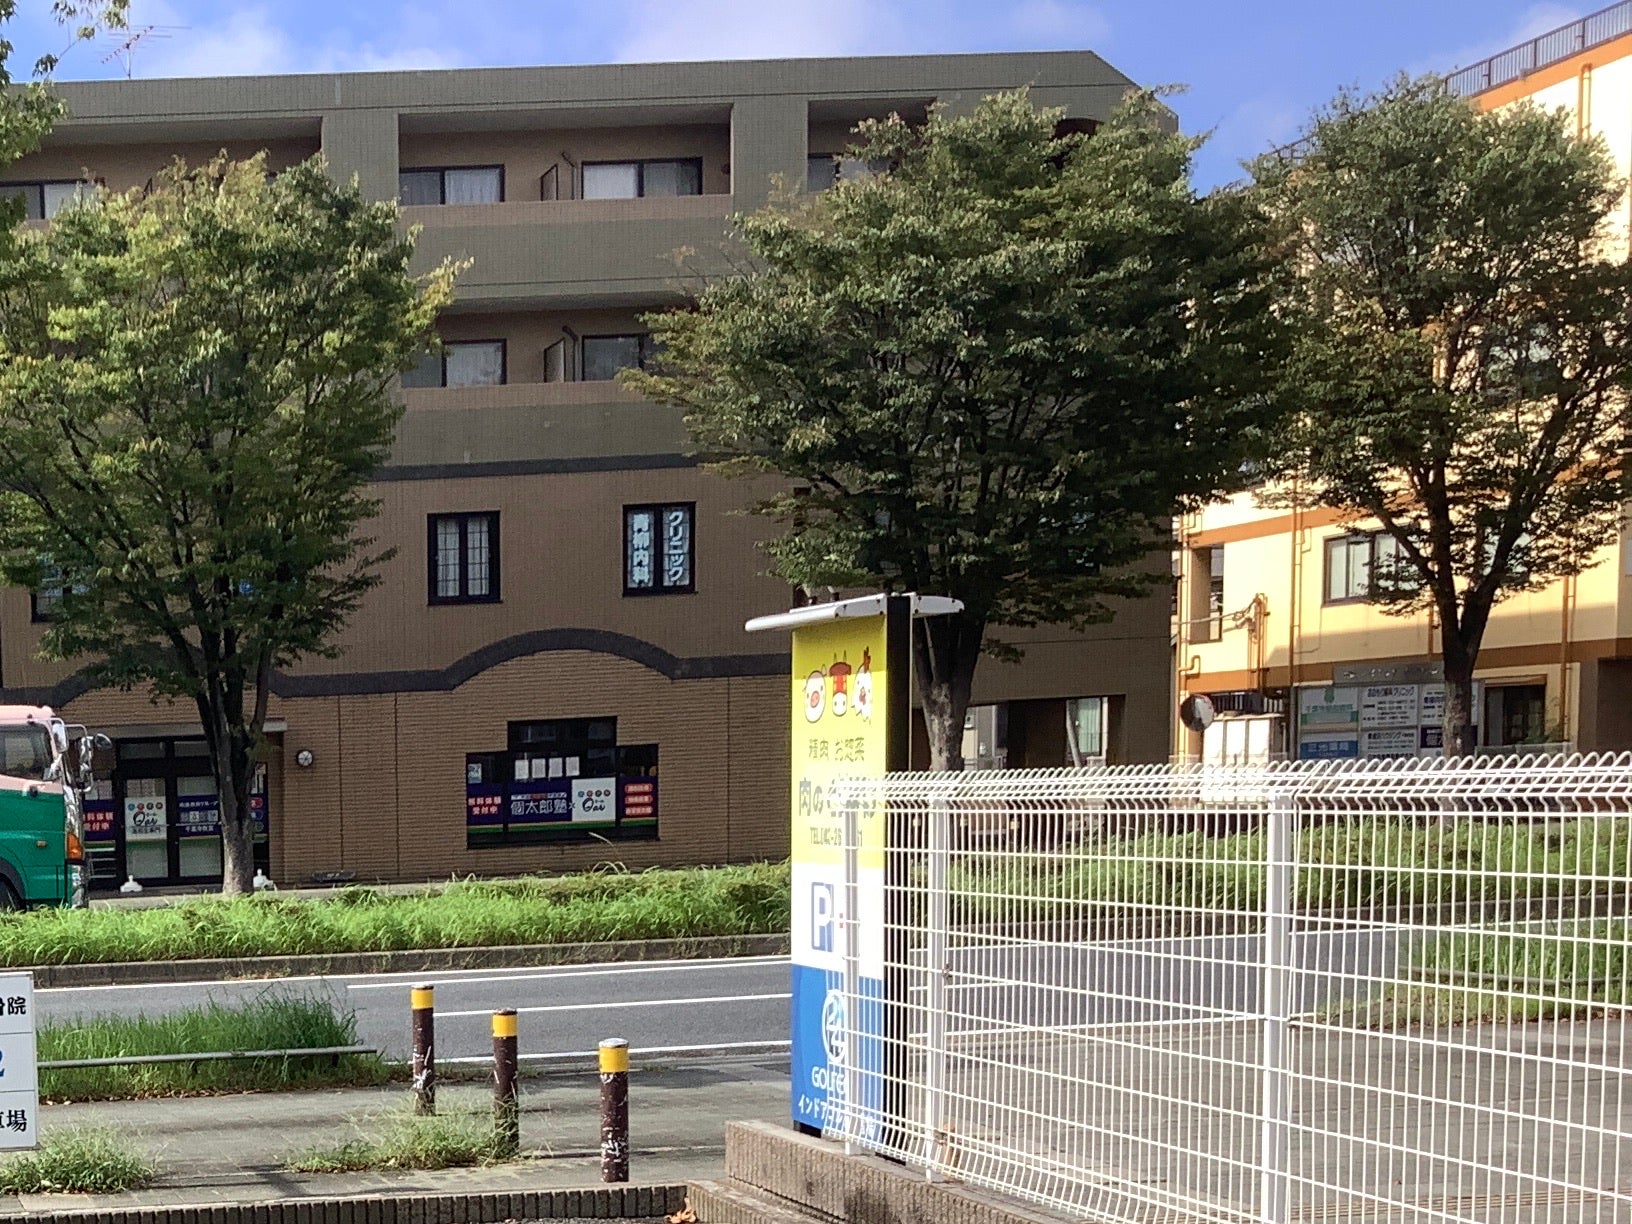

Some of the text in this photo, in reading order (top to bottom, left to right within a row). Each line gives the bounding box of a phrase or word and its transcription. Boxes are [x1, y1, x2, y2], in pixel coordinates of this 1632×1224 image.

[668, 511, 684, 581] クリニック
